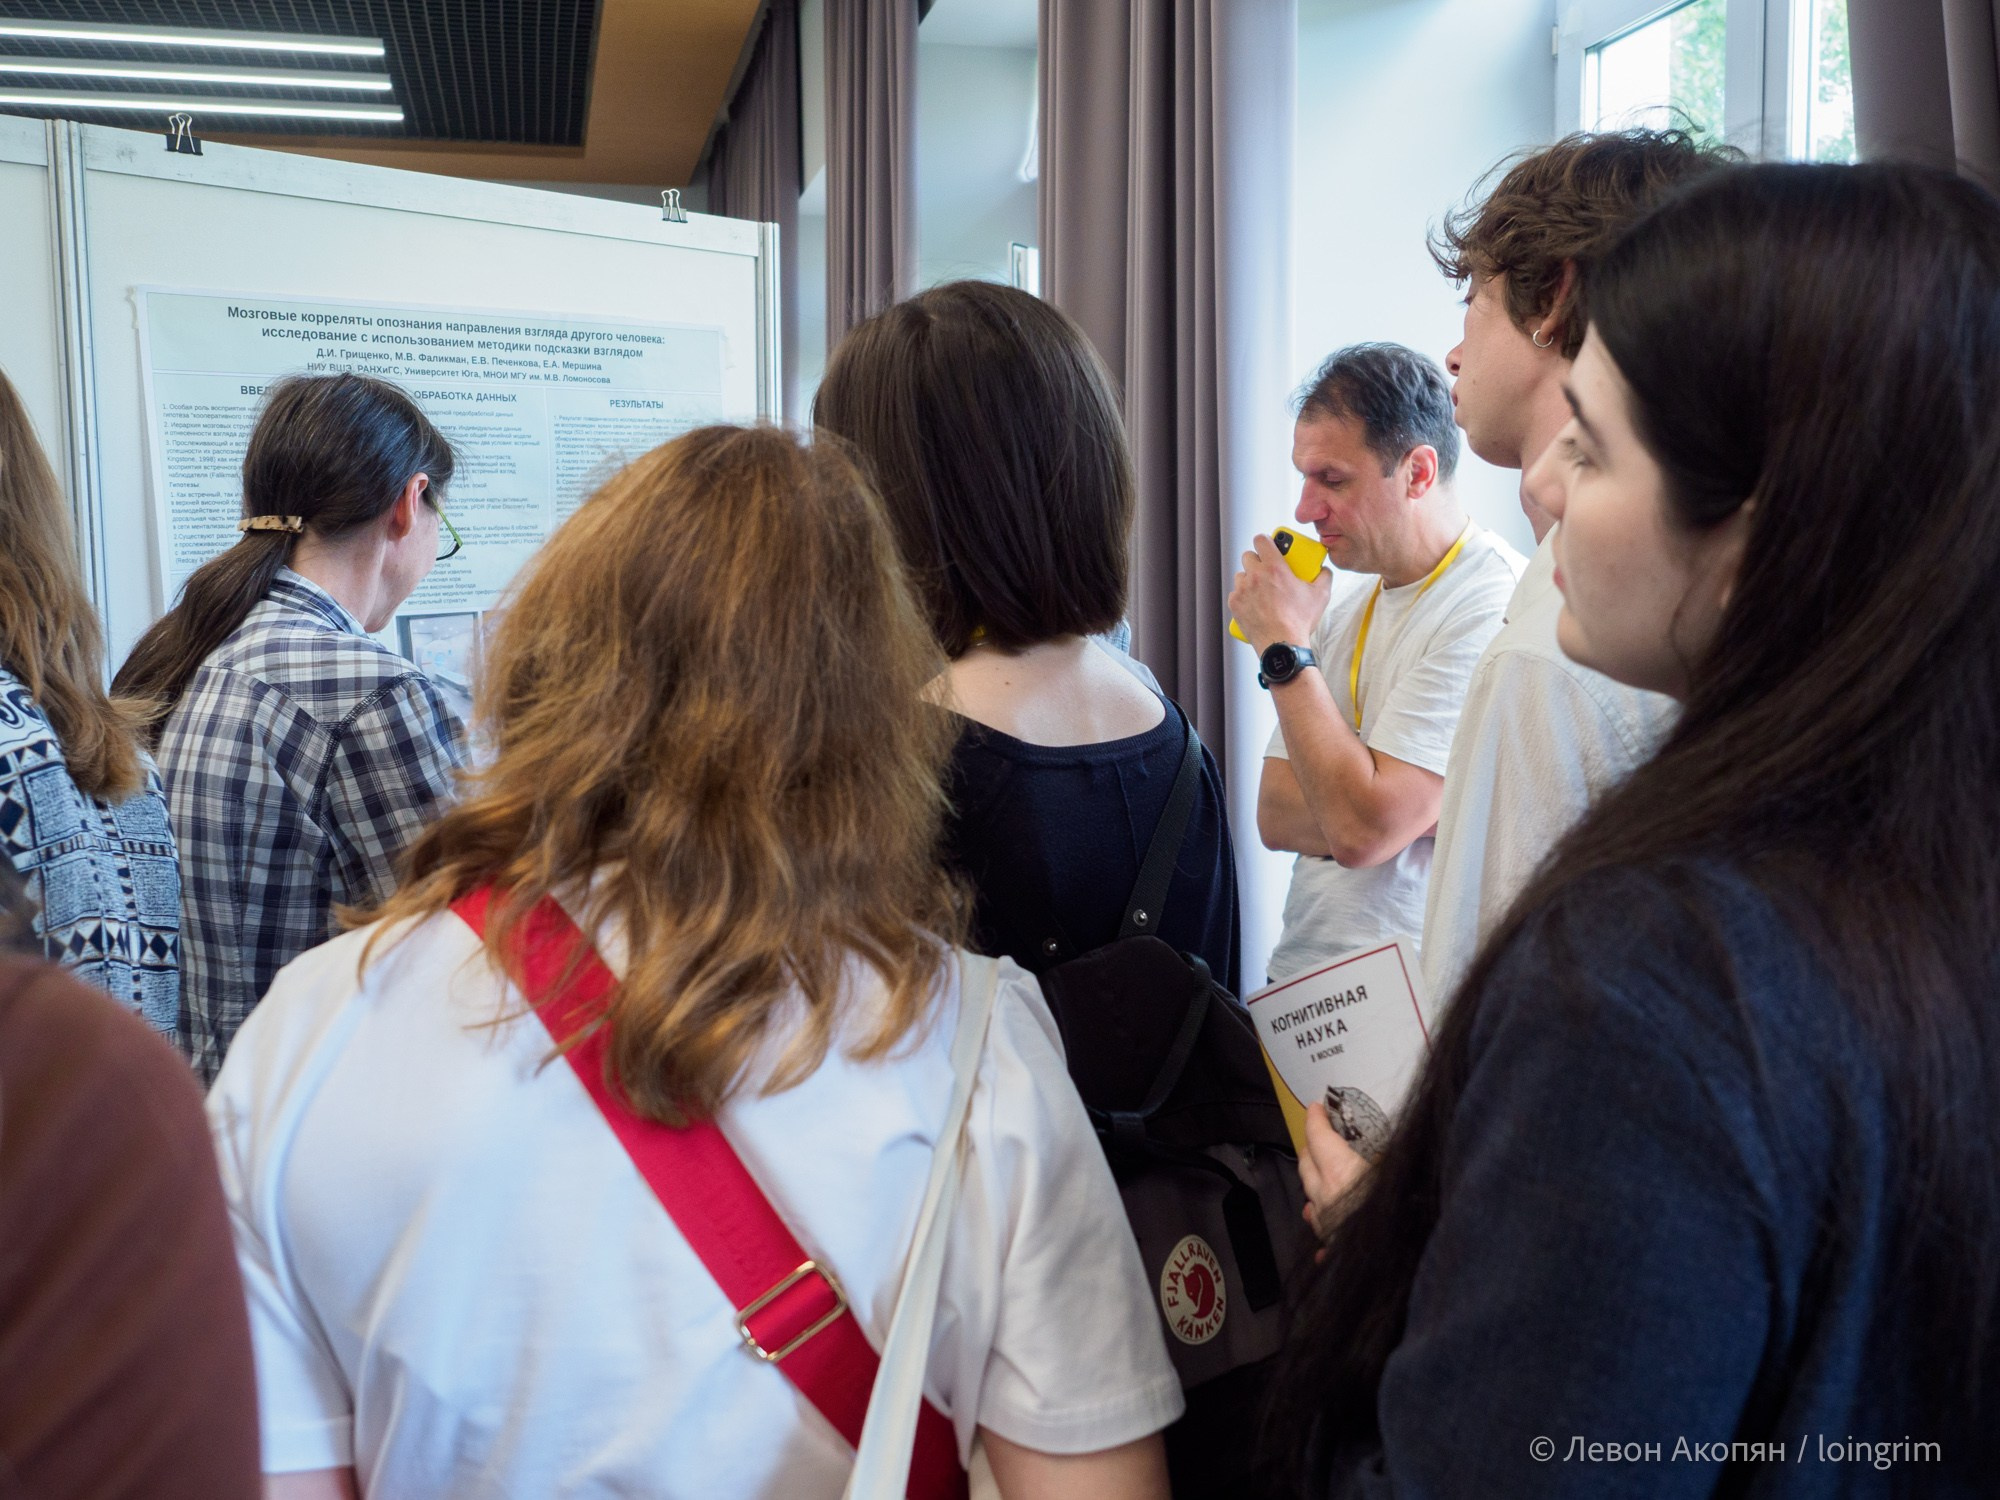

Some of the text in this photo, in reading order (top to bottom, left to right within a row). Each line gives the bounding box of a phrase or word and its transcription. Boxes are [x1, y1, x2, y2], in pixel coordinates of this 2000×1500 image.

[228, 306, 665, 345] Мозговые корреляты опознания направления взгляда другого человека:
[262, 326, 643, 358] исследование с использованием методики подсказки взглядом
[316, 348, 602, 371] Д.И. Грищенко, М.В. Фаликман, Е.В. Печенкова, Е.А. Мершина
[307, 362, 326, 372] НИУ
[358, 365, 402, 376] РАНХиГС,
[404, 367, 459, 379] Университет
[462, 370, 482, 380] Юга,
[483, 370, 508, 379] МНОИ
[510, 372, 526, 380] МГУ
[530, 373, 542, 381] им.
[544, 374, 561, 382] М.В.
[562, 374, 610, 384] Ломоносова
[414, 390, 517, 403] ОБРАБОТКА ДАННЫХ
[609, 399, 664, 409] РЕЗУЛЬТАТЫ
[1270, 984, 1368, 1034] КОГНИТИВНАЯ
[1295, 1019, 1348, 1049] НАУКА
[1316, 1044, 1345, 1060] МОСКВЕ
